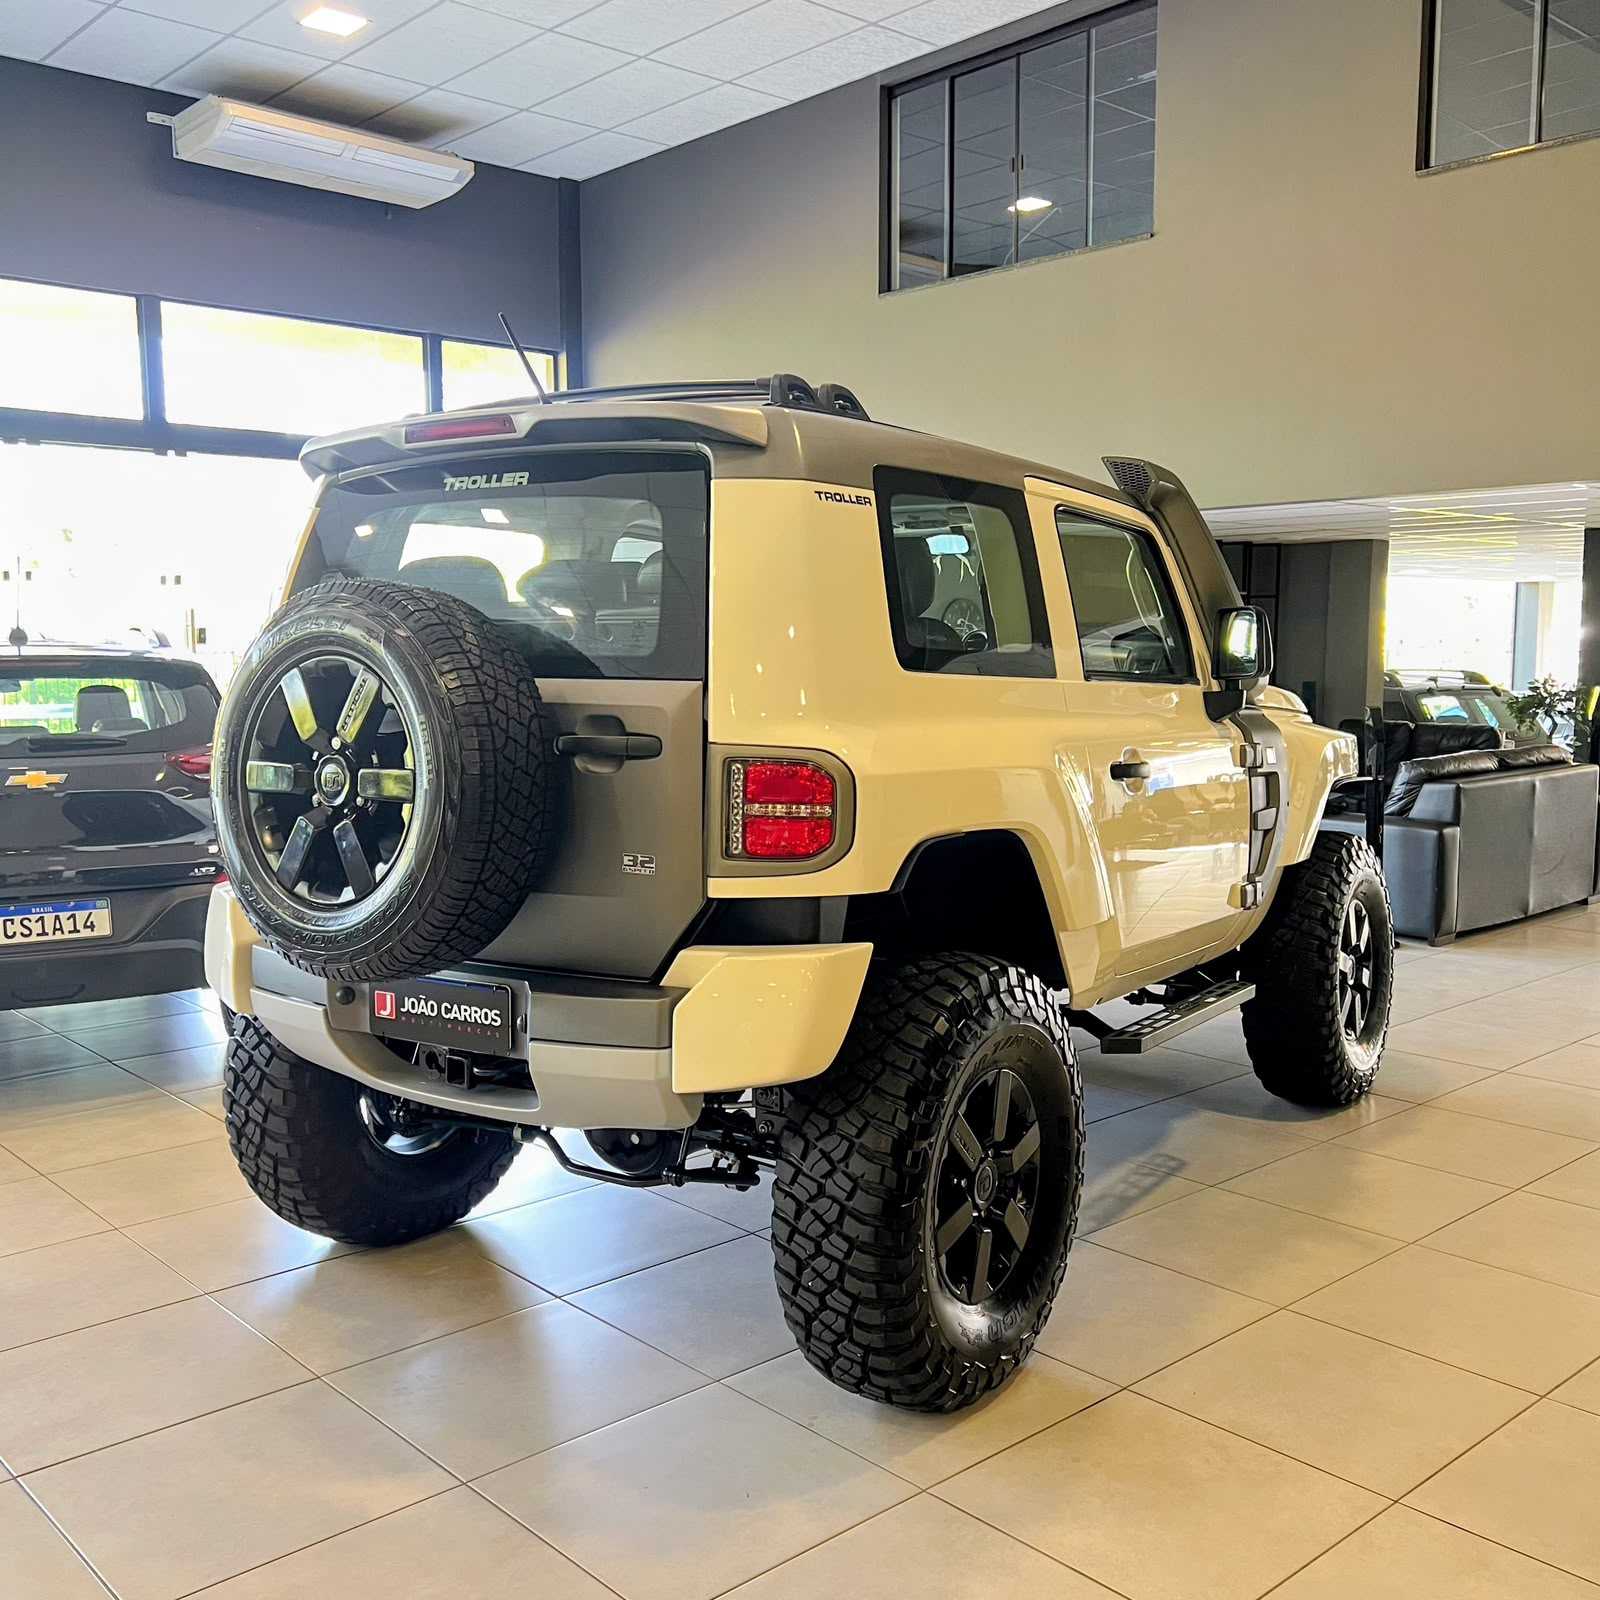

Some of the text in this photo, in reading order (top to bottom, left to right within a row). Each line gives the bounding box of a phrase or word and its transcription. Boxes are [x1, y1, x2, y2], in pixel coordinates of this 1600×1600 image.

[443, 471, 529, 491] TROLLER
[814, 490, 872, 507] TROLLER
[341, 677, 368, 731] TROLLER
[31, 906, 54, 914] BRASIL
[2, 911, 96, 940] CS1A14
[400, 995, 501, 1027] JOÃO CARROS
